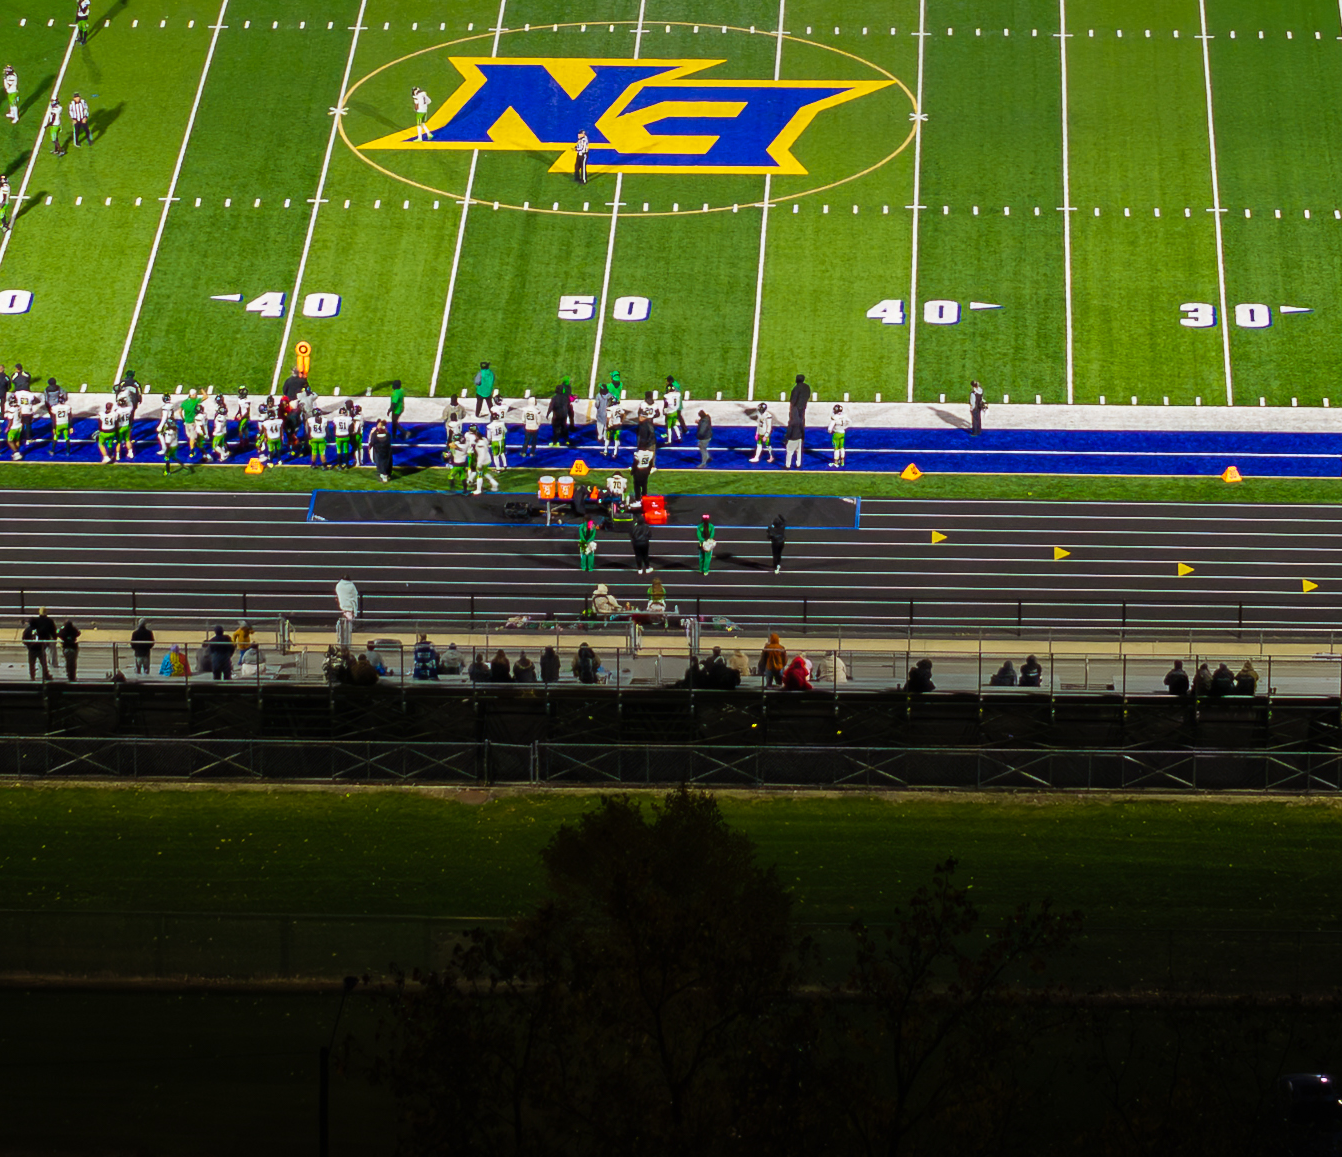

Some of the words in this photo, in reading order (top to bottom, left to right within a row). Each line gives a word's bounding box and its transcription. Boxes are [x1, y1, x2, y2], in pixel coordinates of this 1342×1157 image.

[244, 289, 342, 319] 40
[556, 293, 652, 322] 50
[865, 297, 961, 326] 40
[1178, 301, 1273, 330] 30
